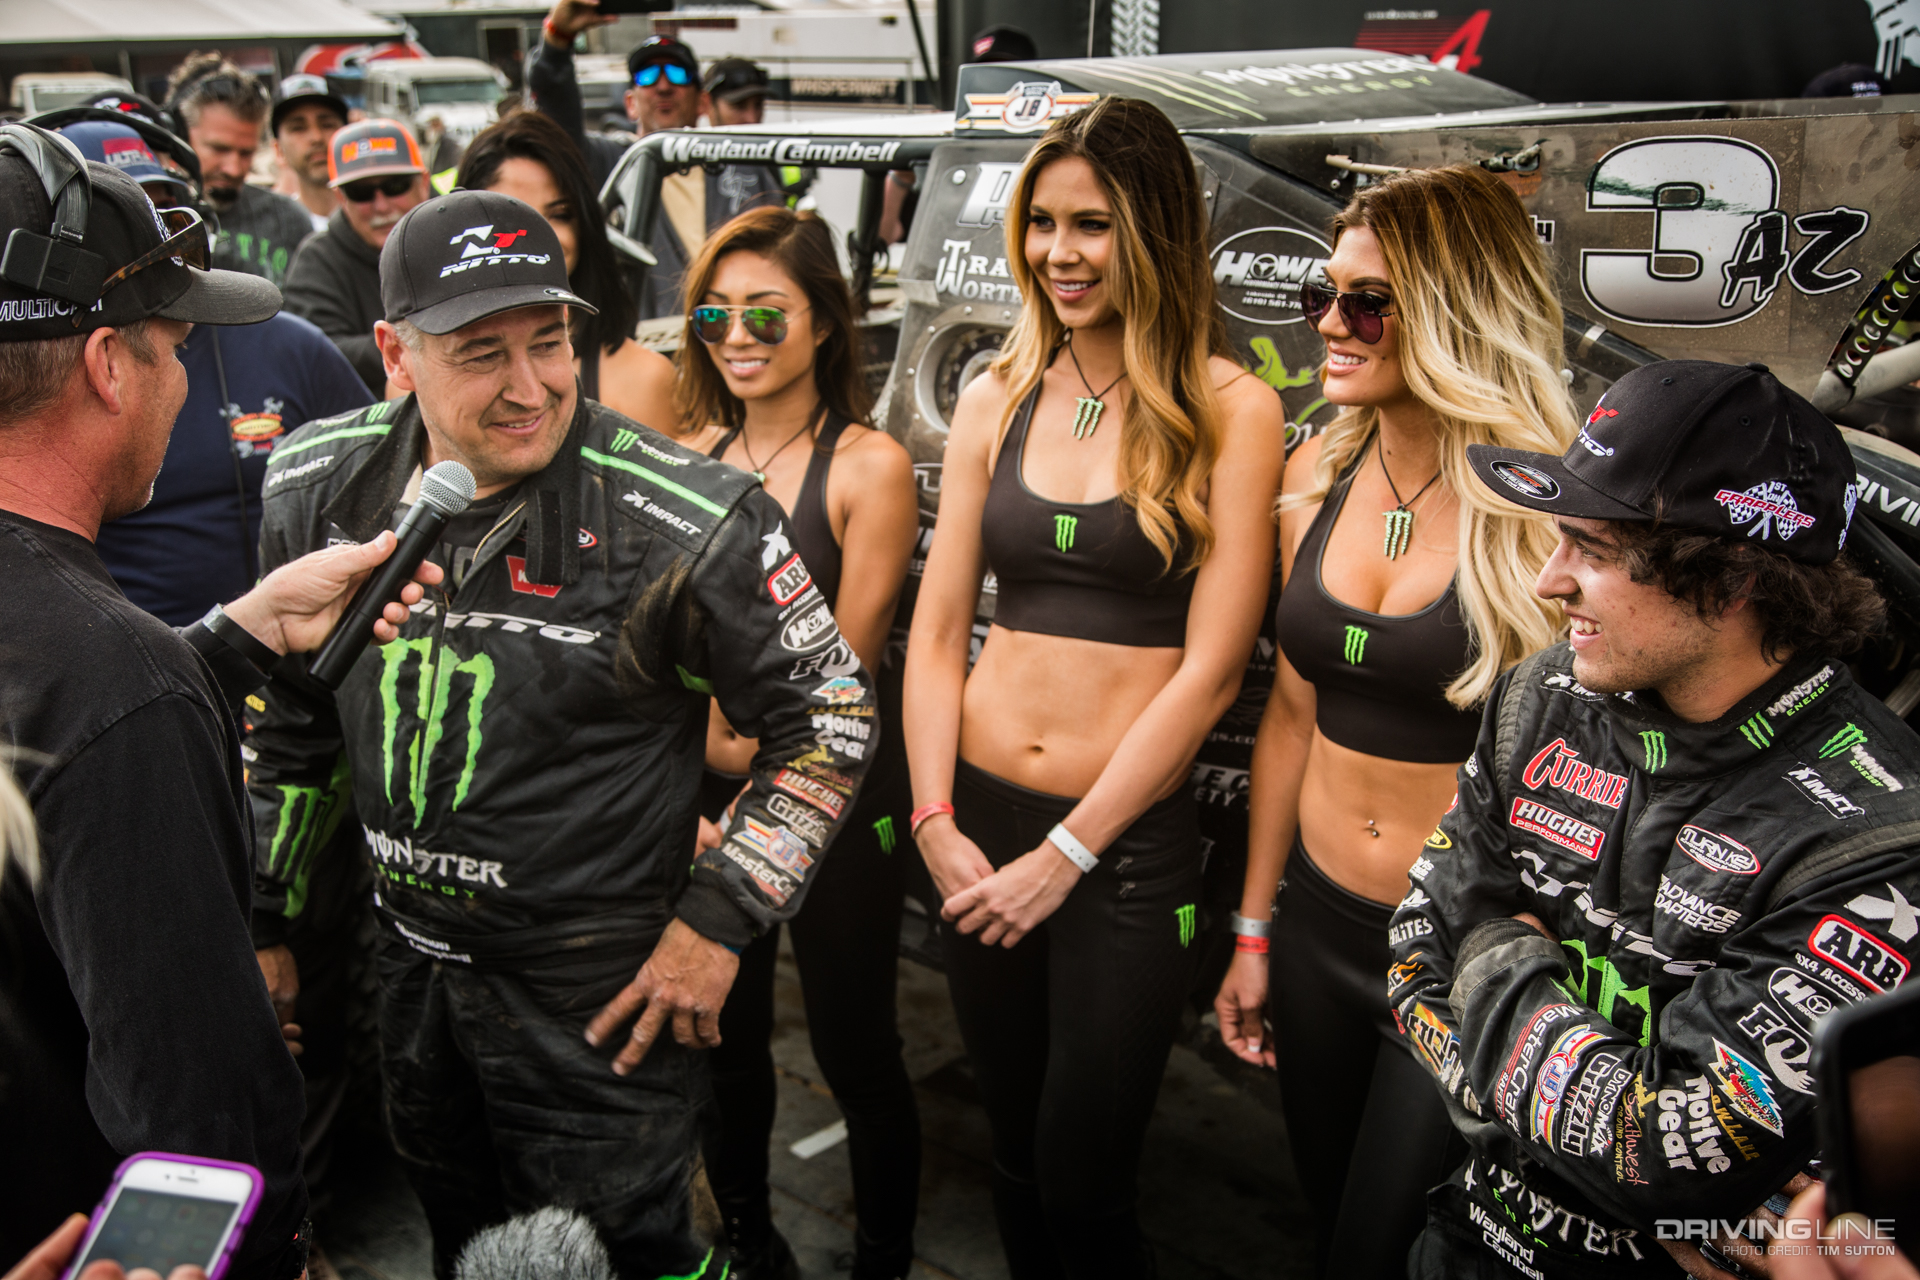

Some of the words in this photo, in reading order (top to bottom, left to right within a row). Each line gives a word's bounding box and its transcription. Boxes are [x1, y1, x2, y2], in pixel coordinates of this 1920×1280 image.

[1202, 56, 1438, 86] MONSTER
[1286, 76, 1433, 97] ENERGY
[661, 136, 778, 163] Wayland
[774, 138, 901, 164] Campbell
[1579, 134, 1781, 329] 3
[1720, 205, 1871, 309] AZ
[439, 253, 551, 278] NITTO
[284, 454, 335, 481] IMPACT
[1767, 481, 1787, 493] 1ST
[643, 501, 702, 537] IMPACT
[1714, 489, 1816, 529] GRAPPLERS
[1765, 665, 1835, 717] MONSTER
[1786, 681, 1830, 717] ENERGY
[1522, 737, 1629, 809] CURRIE
[1849, 759, 1884, 788] ENERGY
[1850, 743, 1904, 792] MONSTER
[1515, 801, 1601, 848] HUGHES
[1516, 818, 1594, 857] PERFORMANCE
[1683, 827, 1729, 860] TURN
[362, 823, 508, 889] MONSTER
[377, 862, 476, 900] ENERGY
[1817, 922, 1904, 986] ARB
[1615, 1104, 1624, 1140] GROUND
[1657, 1088, 1698, 1171] Gear
[1614, 1141, 1625, 1183] CONTROL
[1469, 1201, 1535, 1265] Wayland
